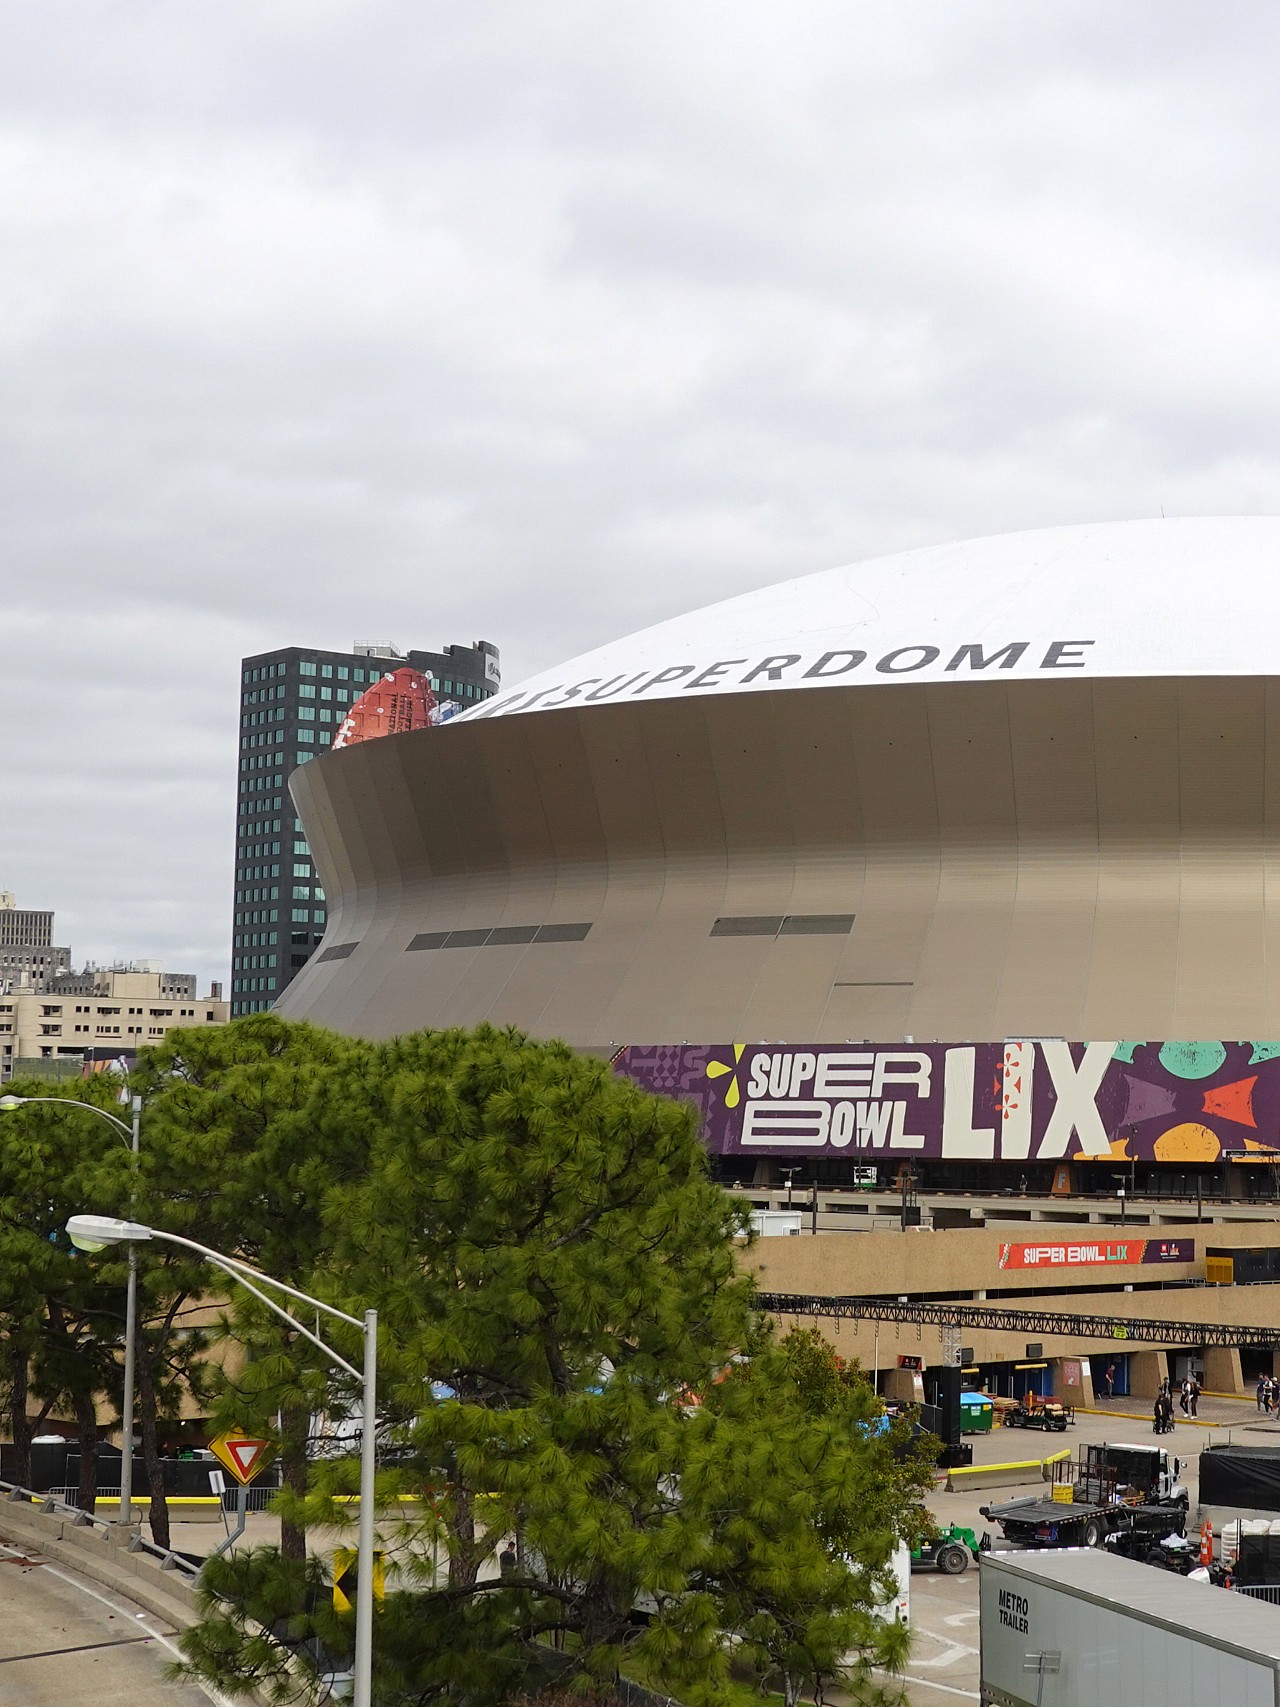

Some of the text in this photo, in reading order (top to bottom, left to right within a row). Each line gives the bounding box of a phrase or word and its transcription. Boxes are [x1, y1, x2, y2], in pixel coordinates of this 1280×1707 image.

[541, 640, 1095, 707] SUPERDOME
[747, 1052, 933, 1098] SUPER
[941, 1041, 1119, 1160] LIX
[741, 1101, 926, 1149] BOWL
[1024, 1245, 1128, 1264] SUPER BOWL LIX
[999, 1589, 1028, 1616] METRO
[999, 1609, 1028, 1635] TRAILER
